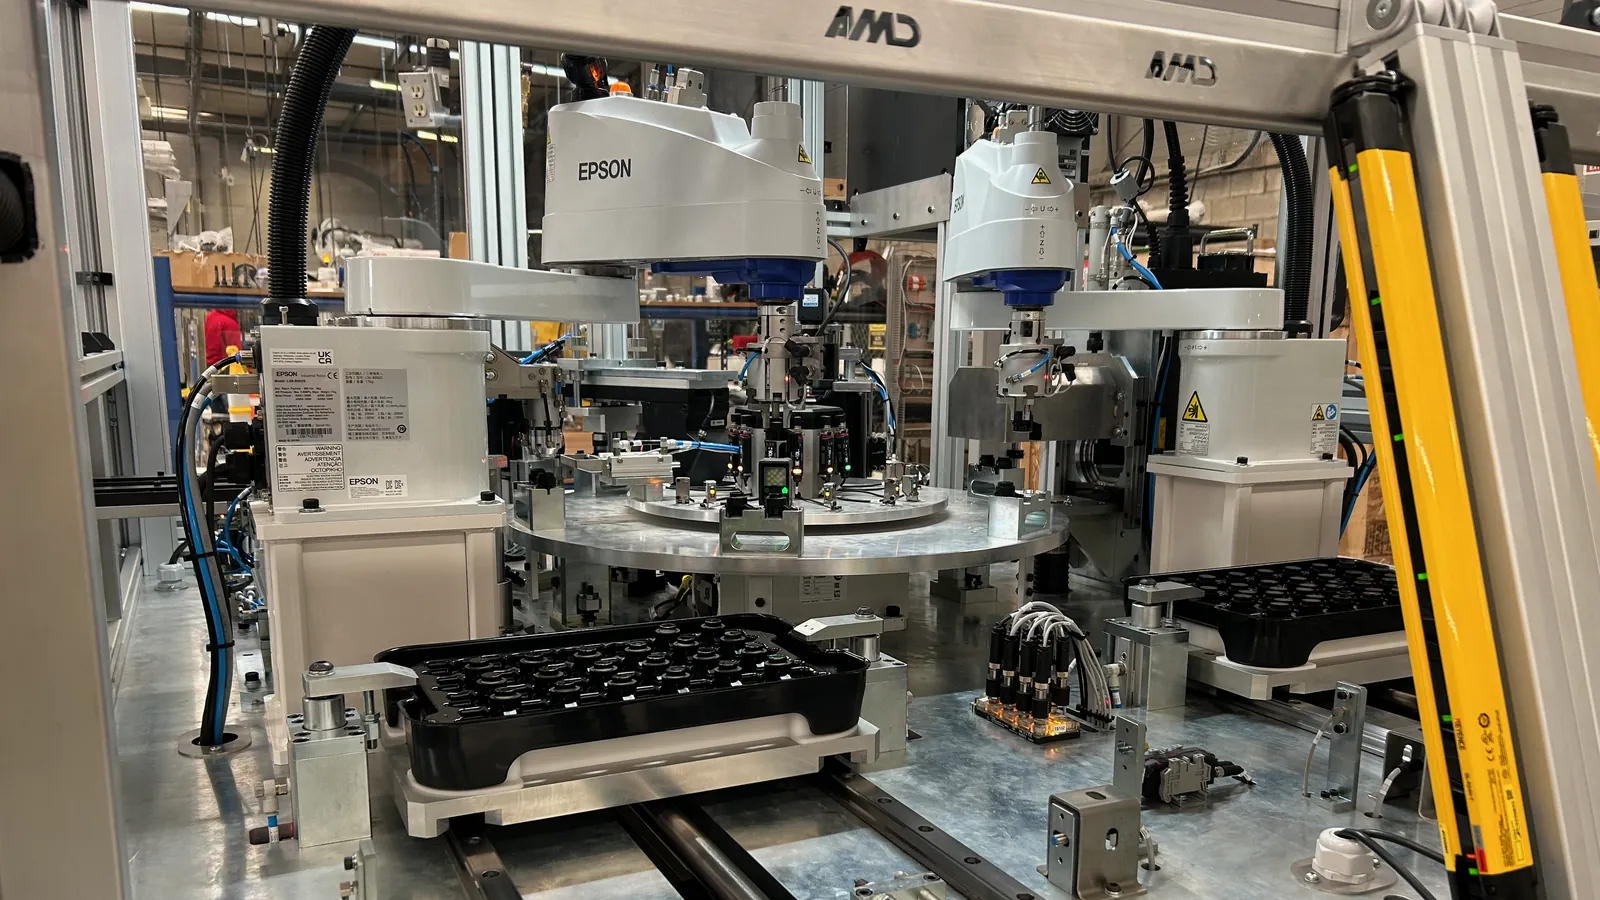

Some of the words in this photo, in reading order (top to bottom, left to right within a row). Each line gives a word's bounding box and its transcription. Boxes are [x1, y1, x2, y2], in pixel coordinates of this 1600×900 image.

[825, 5, 921, 48] AMD
[1144, 51, 1217, 87] AMD
[578, 158, 631, 181] EPSON
[349, 477, 379, 486] EPSON
[1455, 717, 1466, 750] KEYENCE
